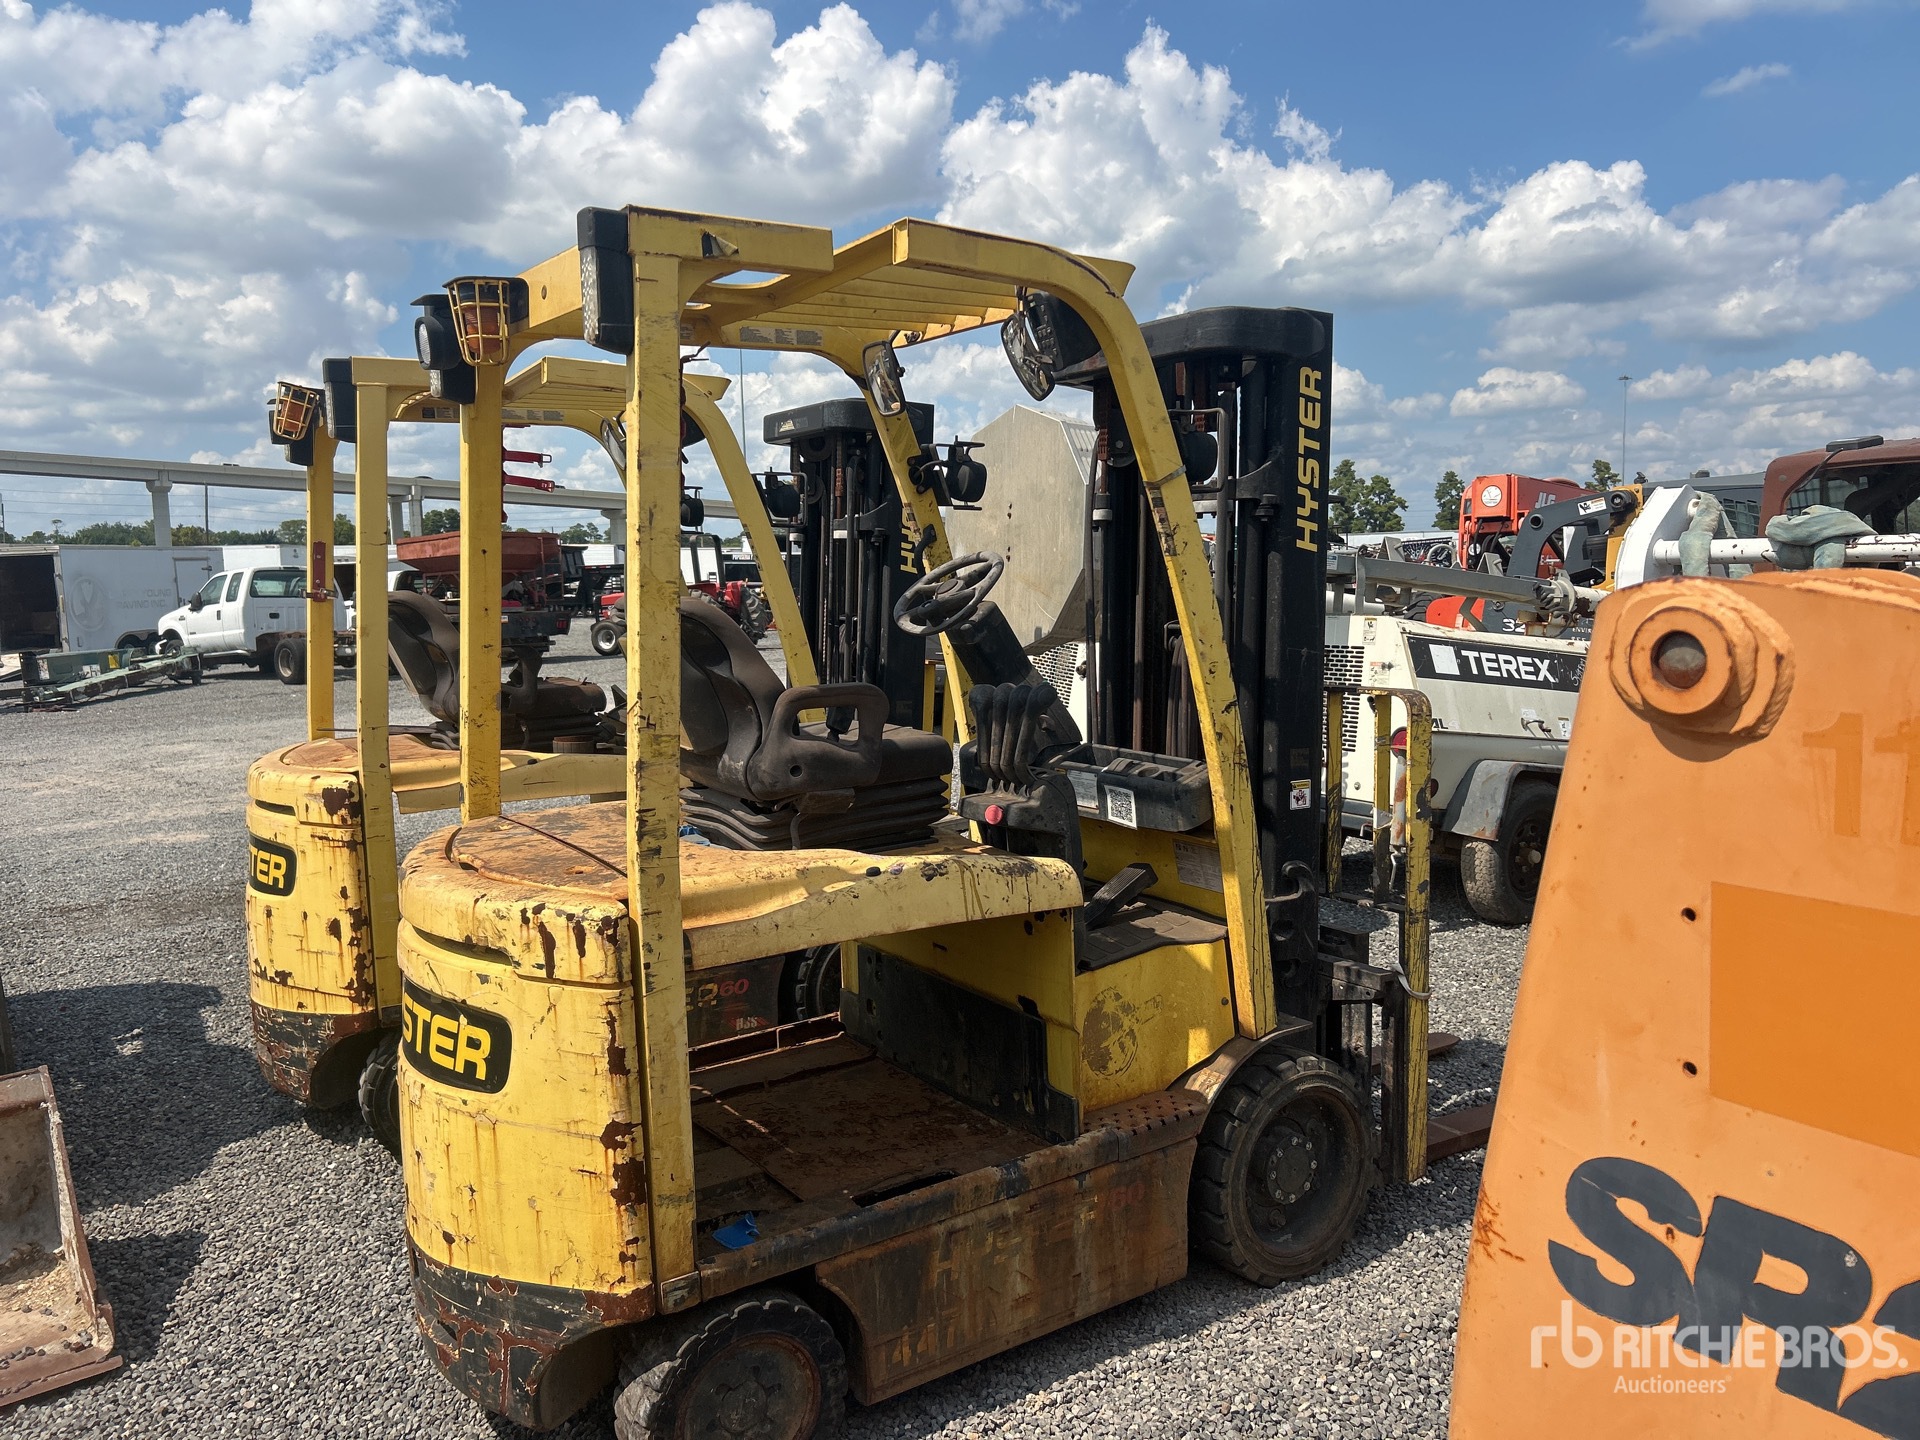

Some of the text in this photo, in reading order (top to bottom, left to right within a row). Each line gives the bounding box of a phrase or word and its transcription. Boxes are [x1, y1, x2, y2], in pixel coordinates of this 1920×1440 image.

[1296, 366, 1322, 552] HYSTER
[1461, 649, 1556, 683] TEREX
[719, 977, 751, 997] 60
